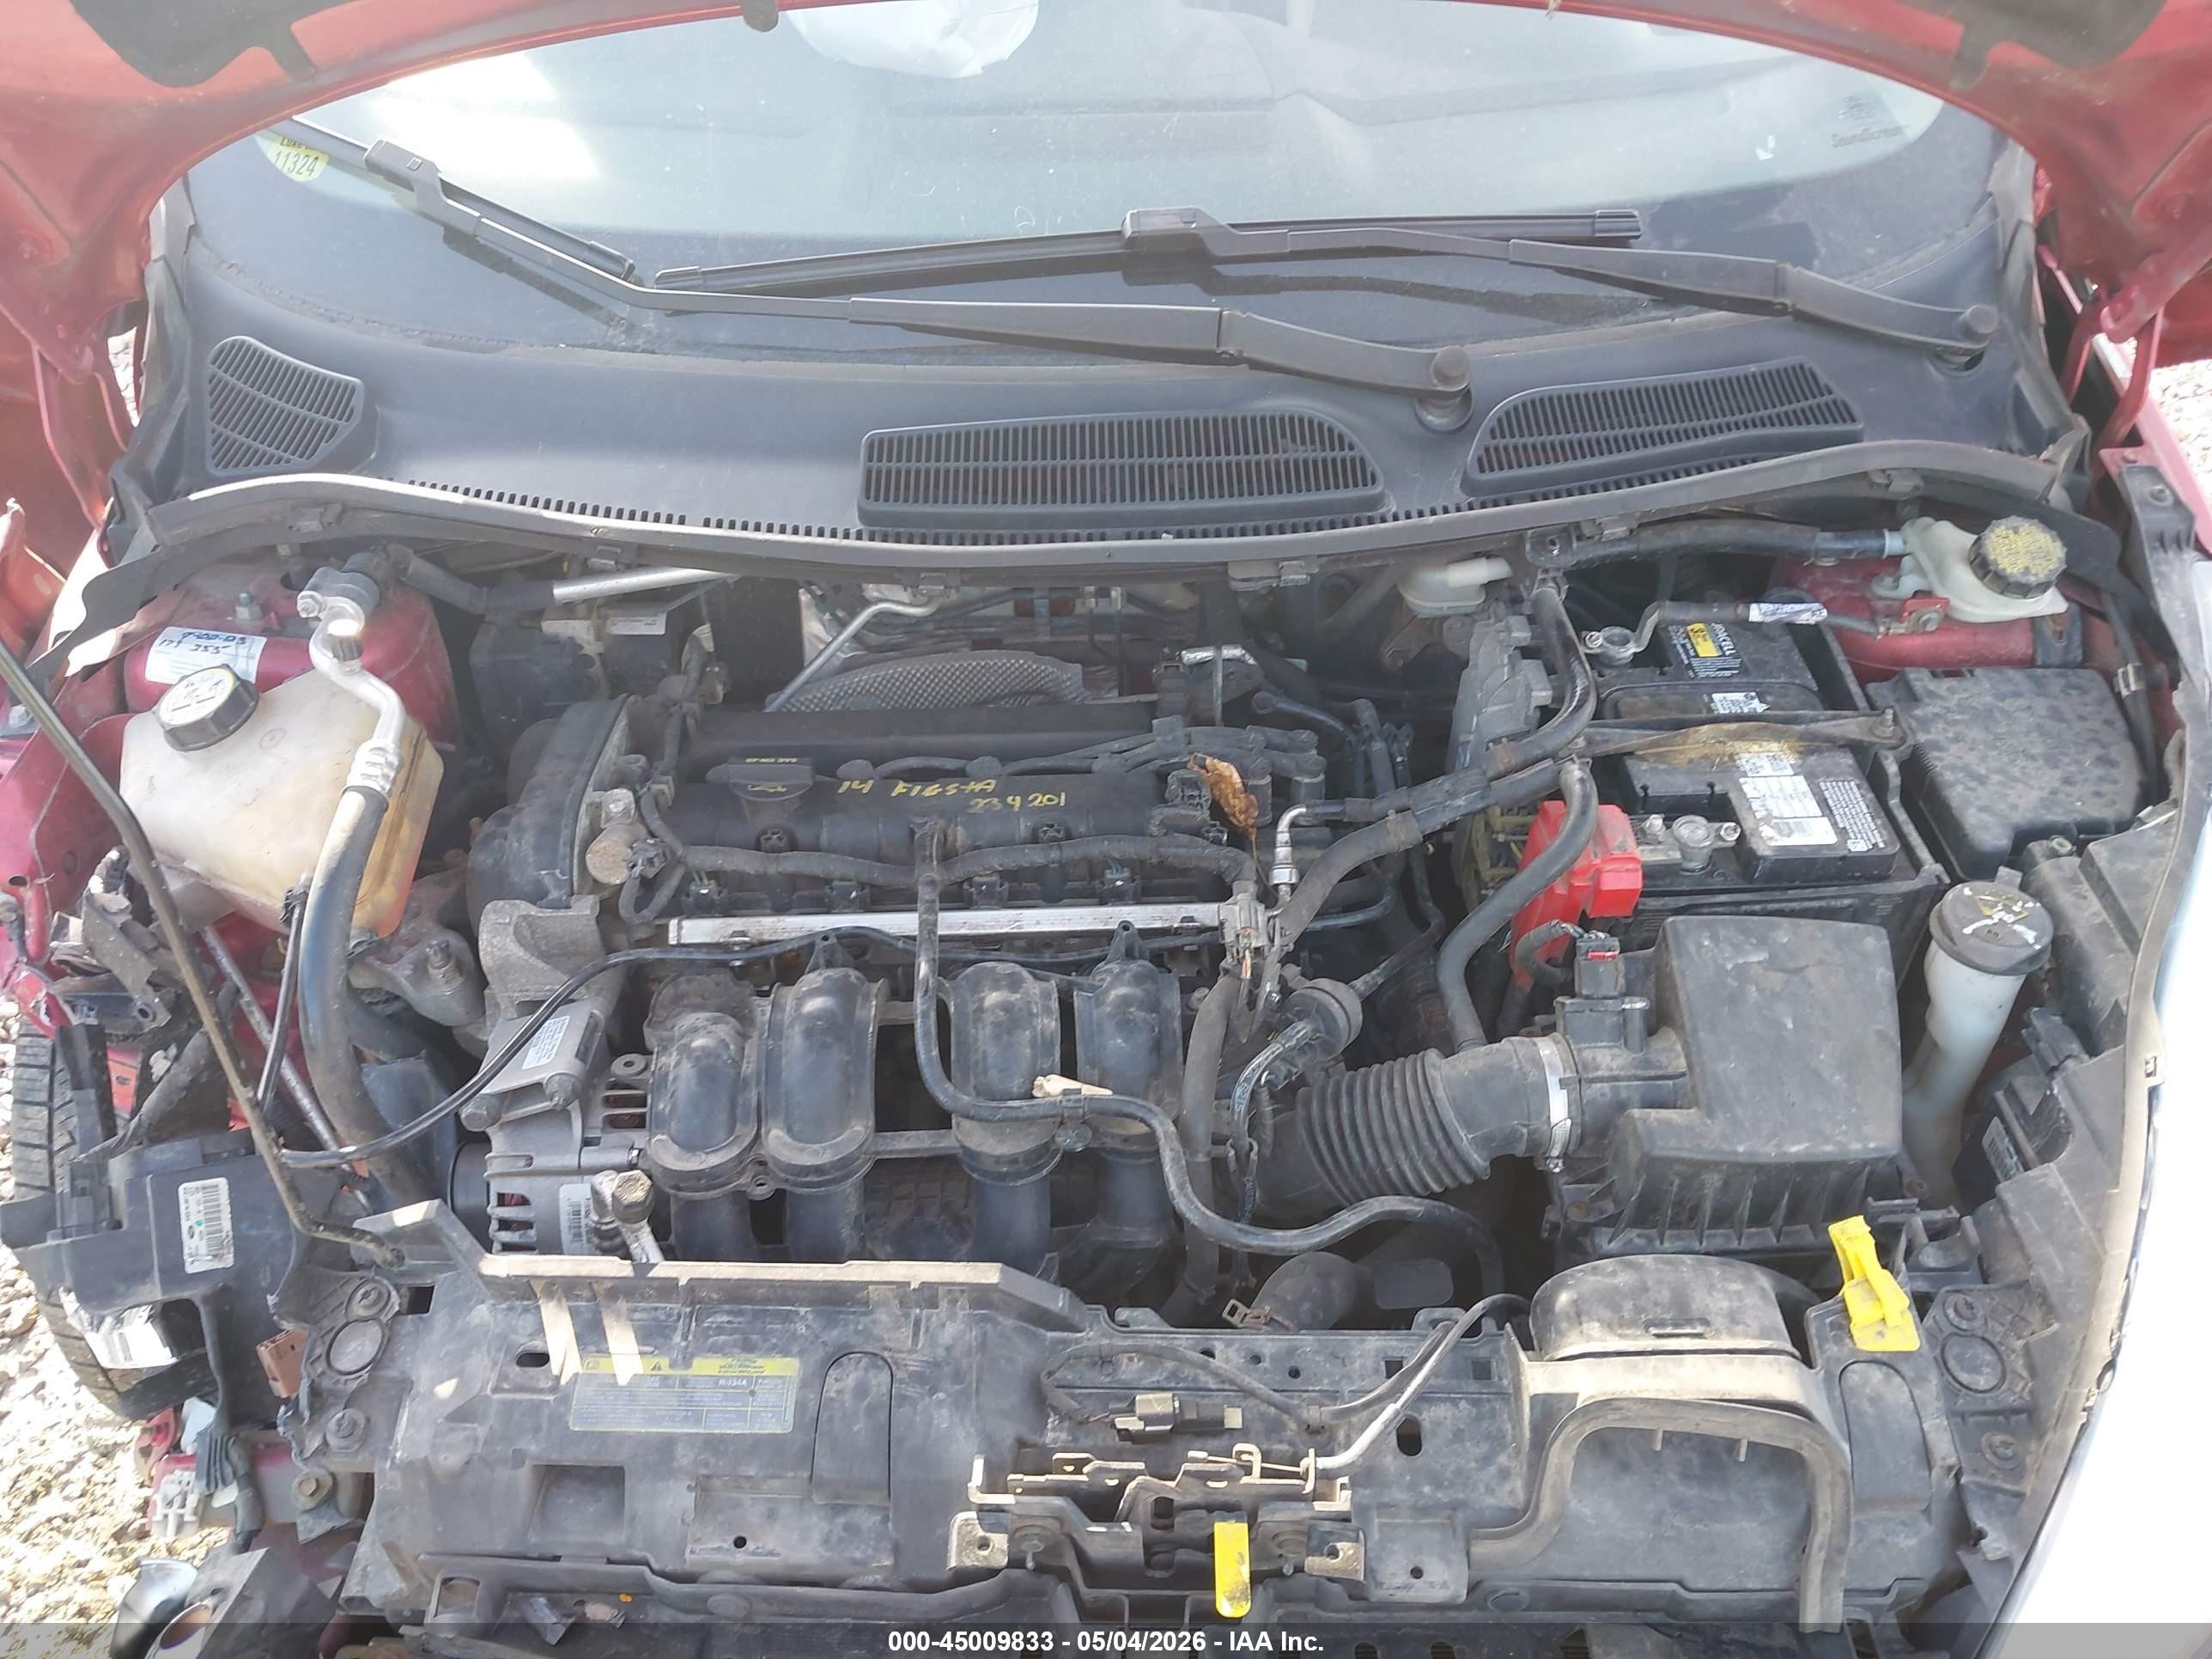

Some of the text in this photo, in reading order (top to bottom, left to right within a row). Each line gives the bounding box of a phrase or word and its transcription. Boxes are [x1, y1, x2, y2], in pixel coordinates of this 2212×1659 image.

[274, 150, 319, 177] 11324
[837, 775, 998, 798] 14 FIESTA
